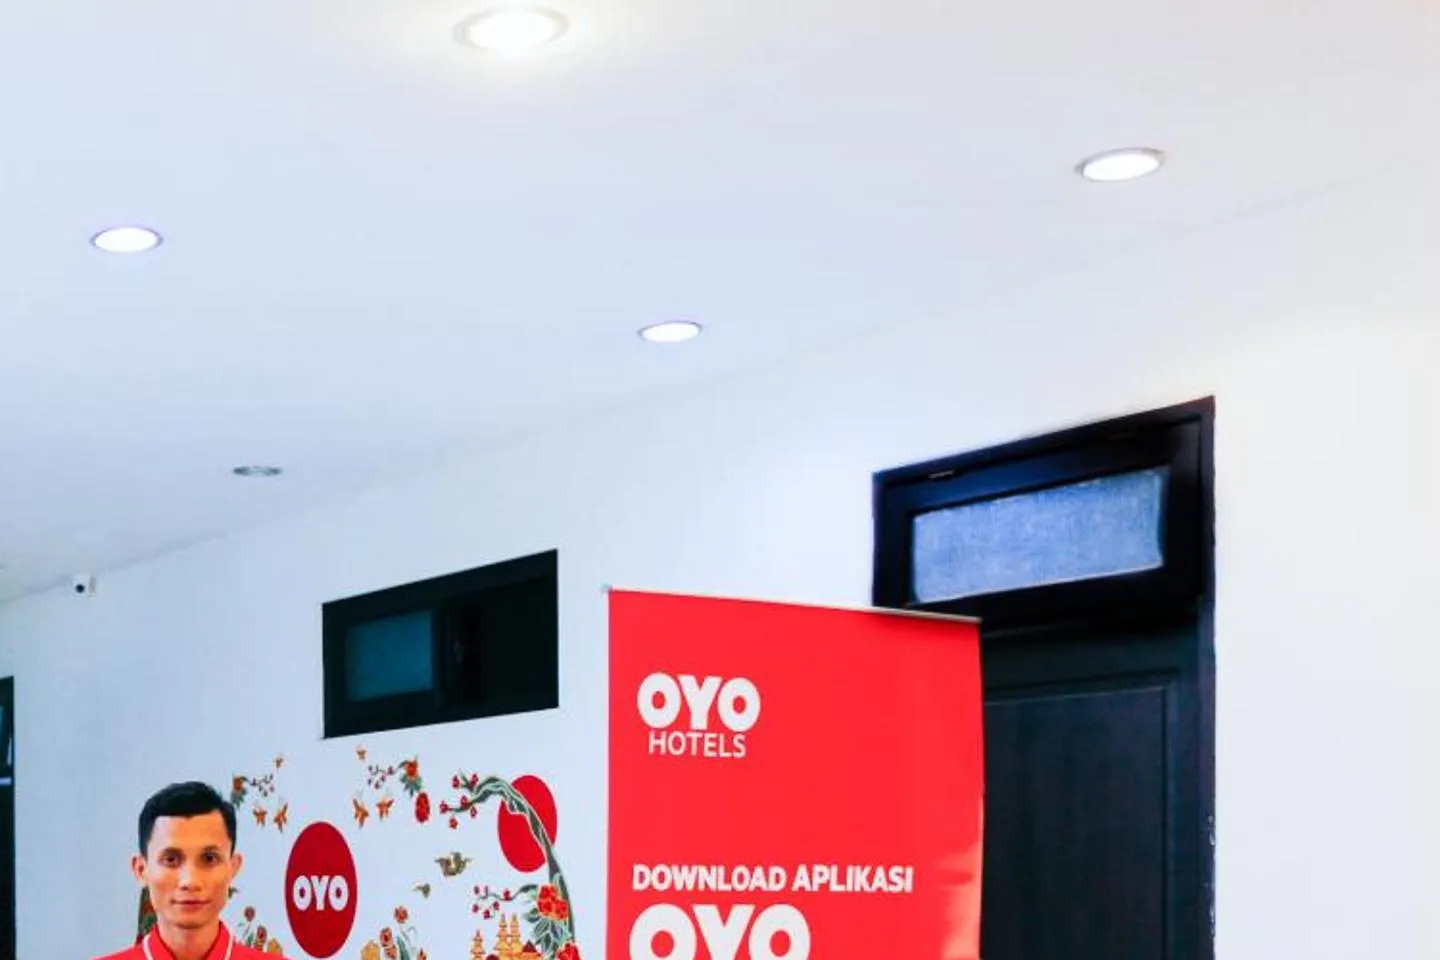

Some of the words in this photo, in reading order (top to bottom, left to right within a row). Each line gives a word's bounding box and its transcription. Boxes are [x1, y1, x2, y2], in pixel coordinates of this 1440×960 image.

[637, 672, 761, 732] OYO
[648, 731, 747, 758] HOTELS
[293, 874, 349, 912] OYO
[631, 864, 787, 892] DOWNLOAD
[791, 863, 914, 893] APLIKASI
